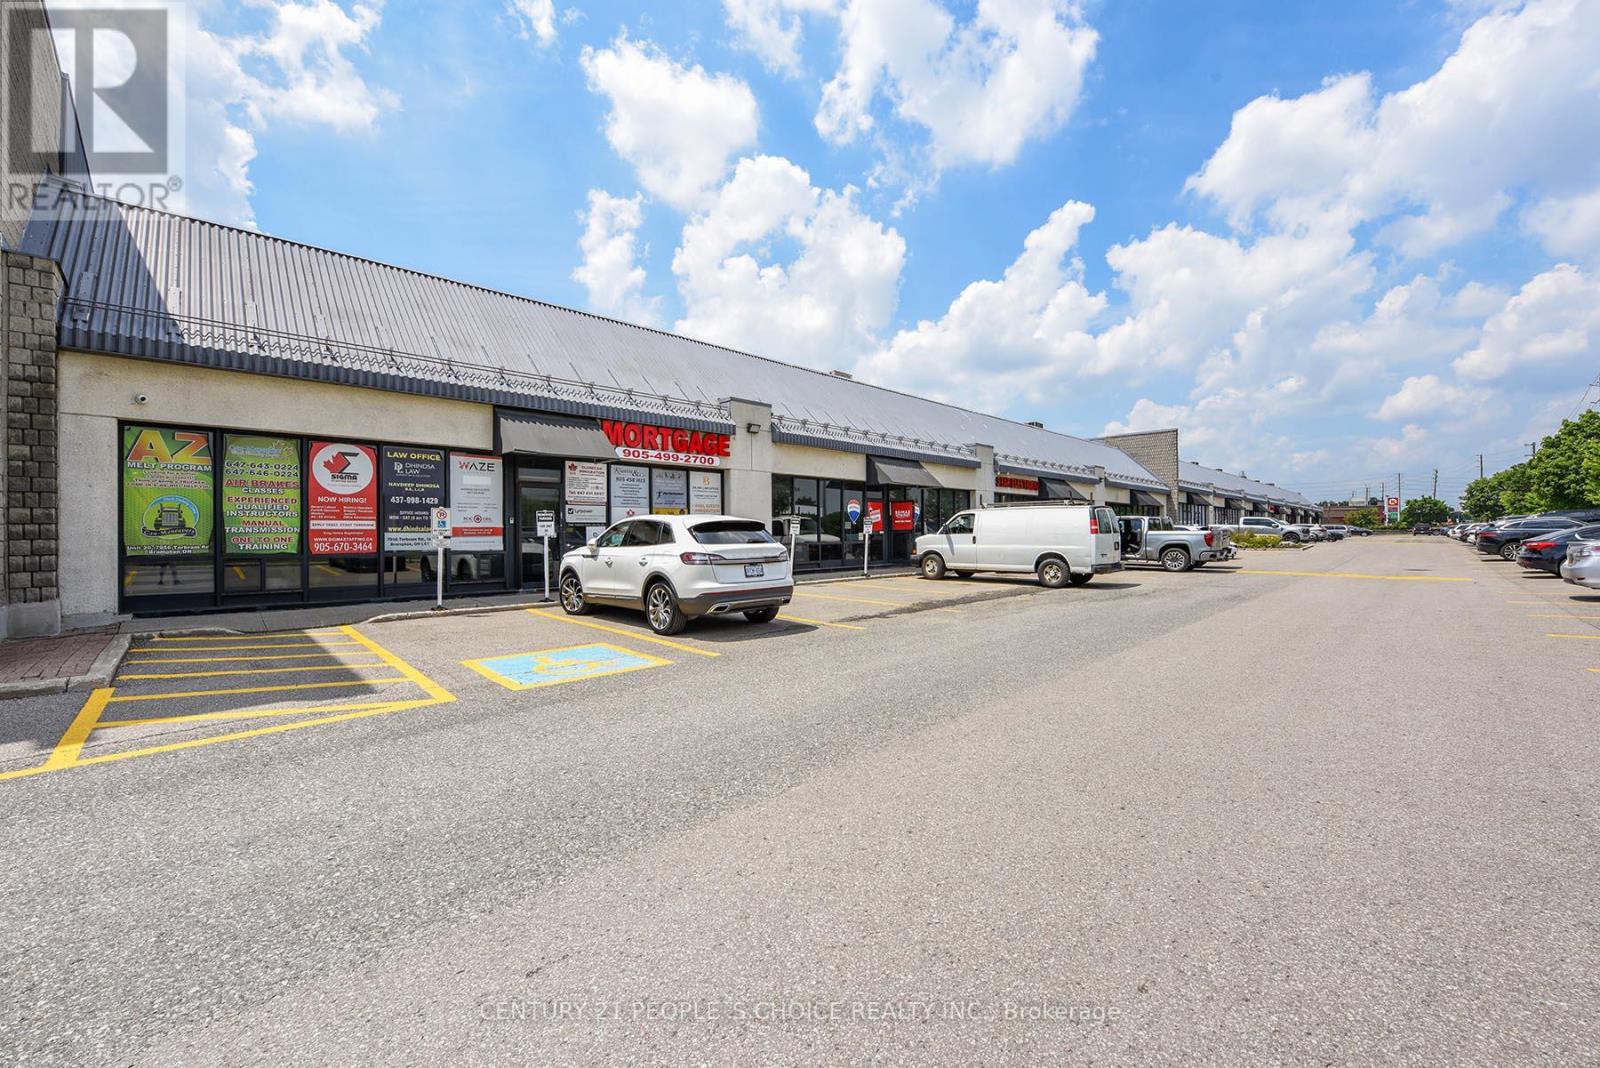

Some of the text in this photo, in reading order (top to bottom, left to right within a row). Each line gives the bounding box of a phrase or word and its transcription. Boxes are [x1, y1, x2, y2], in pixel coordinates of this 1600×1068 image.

[601, 419, 731, 457] MORTGAGE
[127, 429, 212, 465] AZ
[409, 452, 441, 461] OFFICE
[622, 448, 715, 465] 905-499-2700
[127, 461, 212, 472] MELT PROGRAM
[459, 461, 496, 472] WAZE
[224, 479, 300, 489] AIR BRAKES
[241, 487, 284, 495] CLASSES
[227, 496, 298, 505] EXPERIENCED
[390, 496, 439, 505] 437-998-1429
[226, 510, 299, 518] INSTRUCTORS
[224, 526, 300, 534] TRANSMISSION
[314, 542, 373, 552] 905-670-3464
